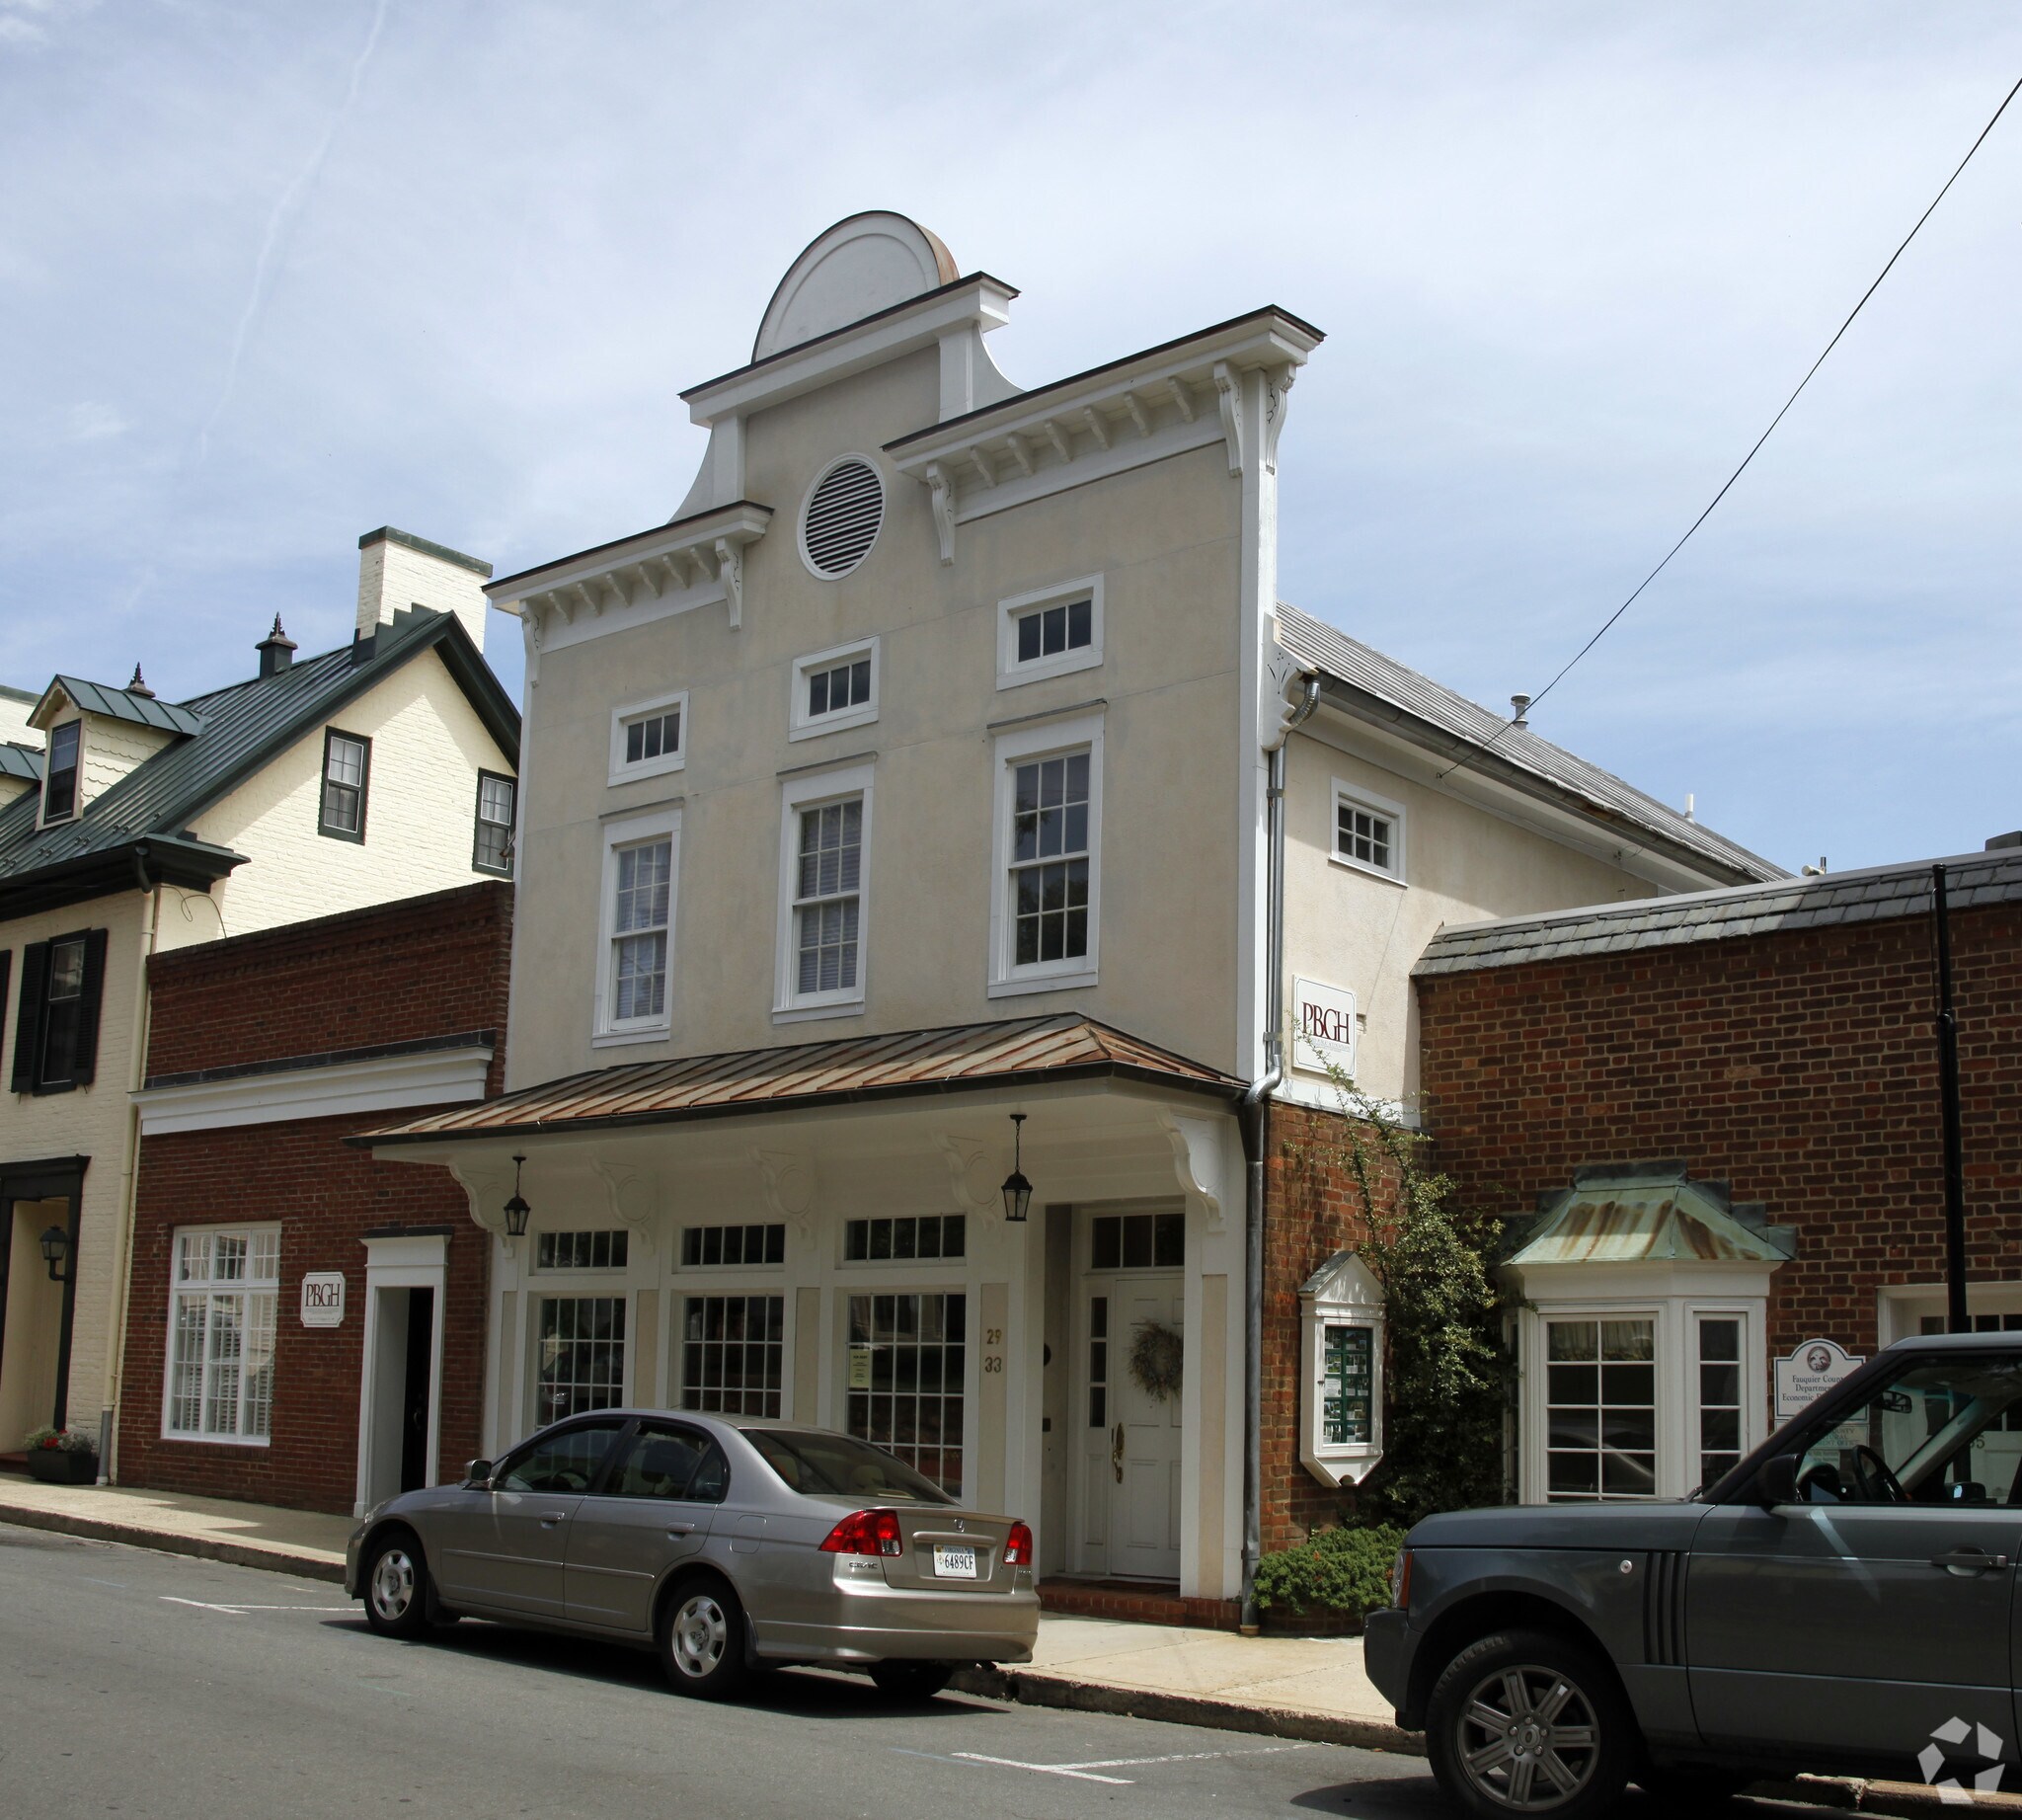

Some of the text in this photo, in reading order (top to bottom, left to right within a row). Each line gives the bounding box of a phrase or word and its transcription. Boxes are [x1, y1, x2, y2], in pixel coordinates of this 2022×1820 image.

[1302, 1001, 1350, 1045] PBGH
[305, 1284, 341, 1306] PBGH
[986, 1328, 1002, 1345] 29
[984, 1356, 1002, 1373] 33
[1792, 1375, 1821, 1385] Fauquier
[1795, 1384, 1832, 1392] Departmen
[1782, 1392, 1814, 1401] Economic
[945, 1554, 973, 1570] 6489CF
